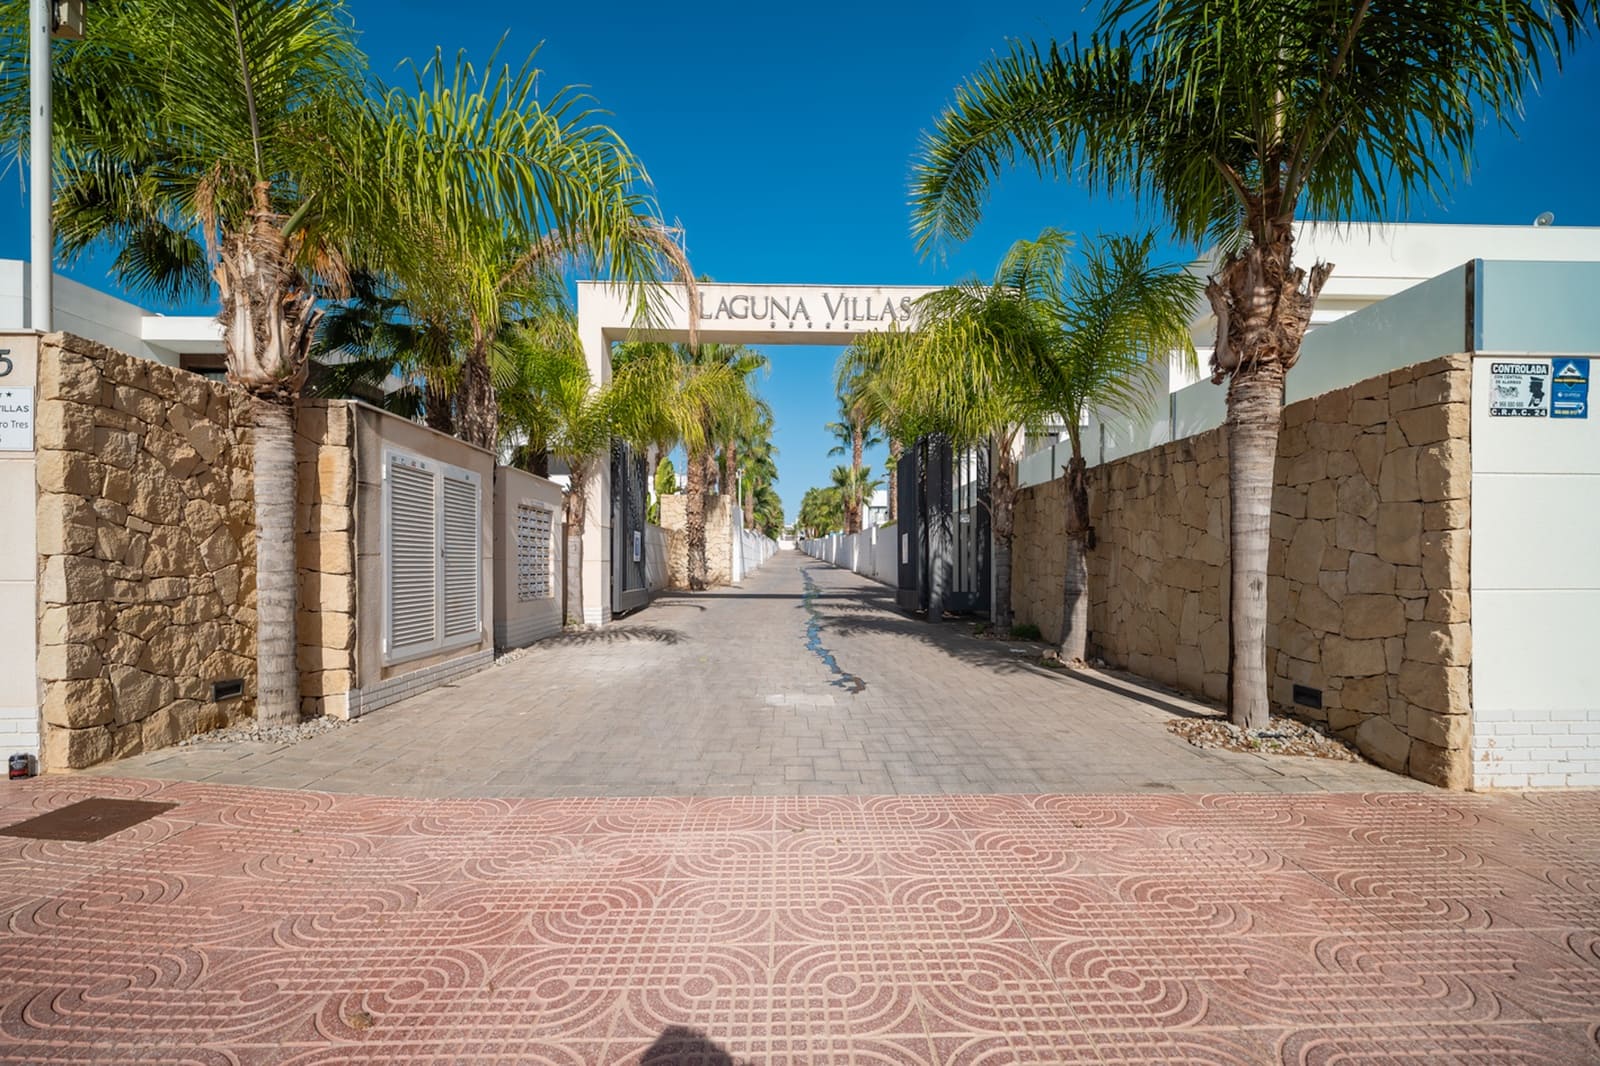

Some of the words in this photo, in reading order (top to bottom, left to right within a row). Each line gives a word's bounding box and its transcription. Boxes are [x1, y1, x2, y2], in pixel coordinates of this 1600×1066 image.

[1492, 364, 1547, 374] CONTROLADA
[0, 404, 30, 413] ILLAS
[10, 419, 29, 429] Tres
